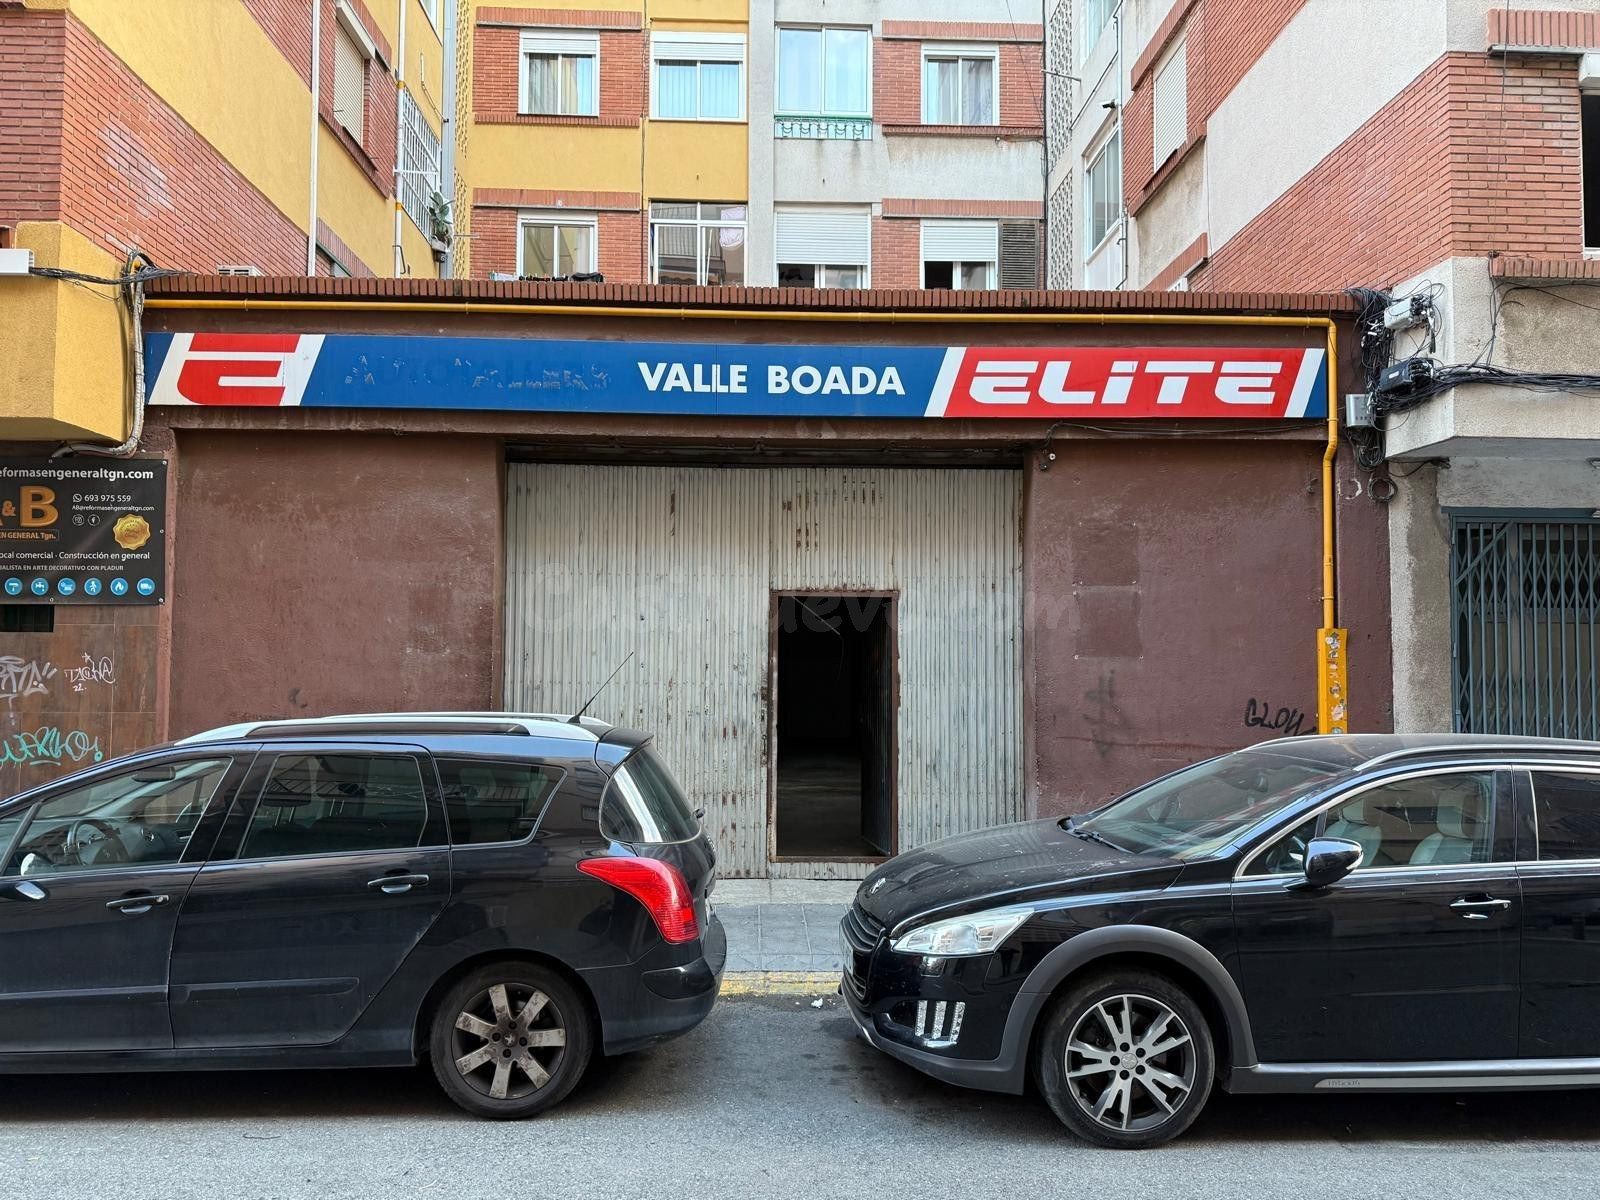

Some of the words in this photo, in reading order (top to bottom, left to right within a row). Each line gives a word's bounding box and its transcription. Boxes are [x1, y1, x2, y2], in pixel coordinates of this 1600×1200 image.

[637, 362, 748, 393] VALLE
[767, 365, 906, 395] BOADA
[84, 494, 99, 502] 693
[100, 494, 115, 502] 975
[117, 494, 132, 502] 559
[2, 500, 16, 517] &
[19, 485, 59, 528] B
[8, 532, 40, 540] GENERAL
[16, 551, 54, 560] comercial
[59, 551, 109, 560] Construcción
[121, 552, 151, 562] general
